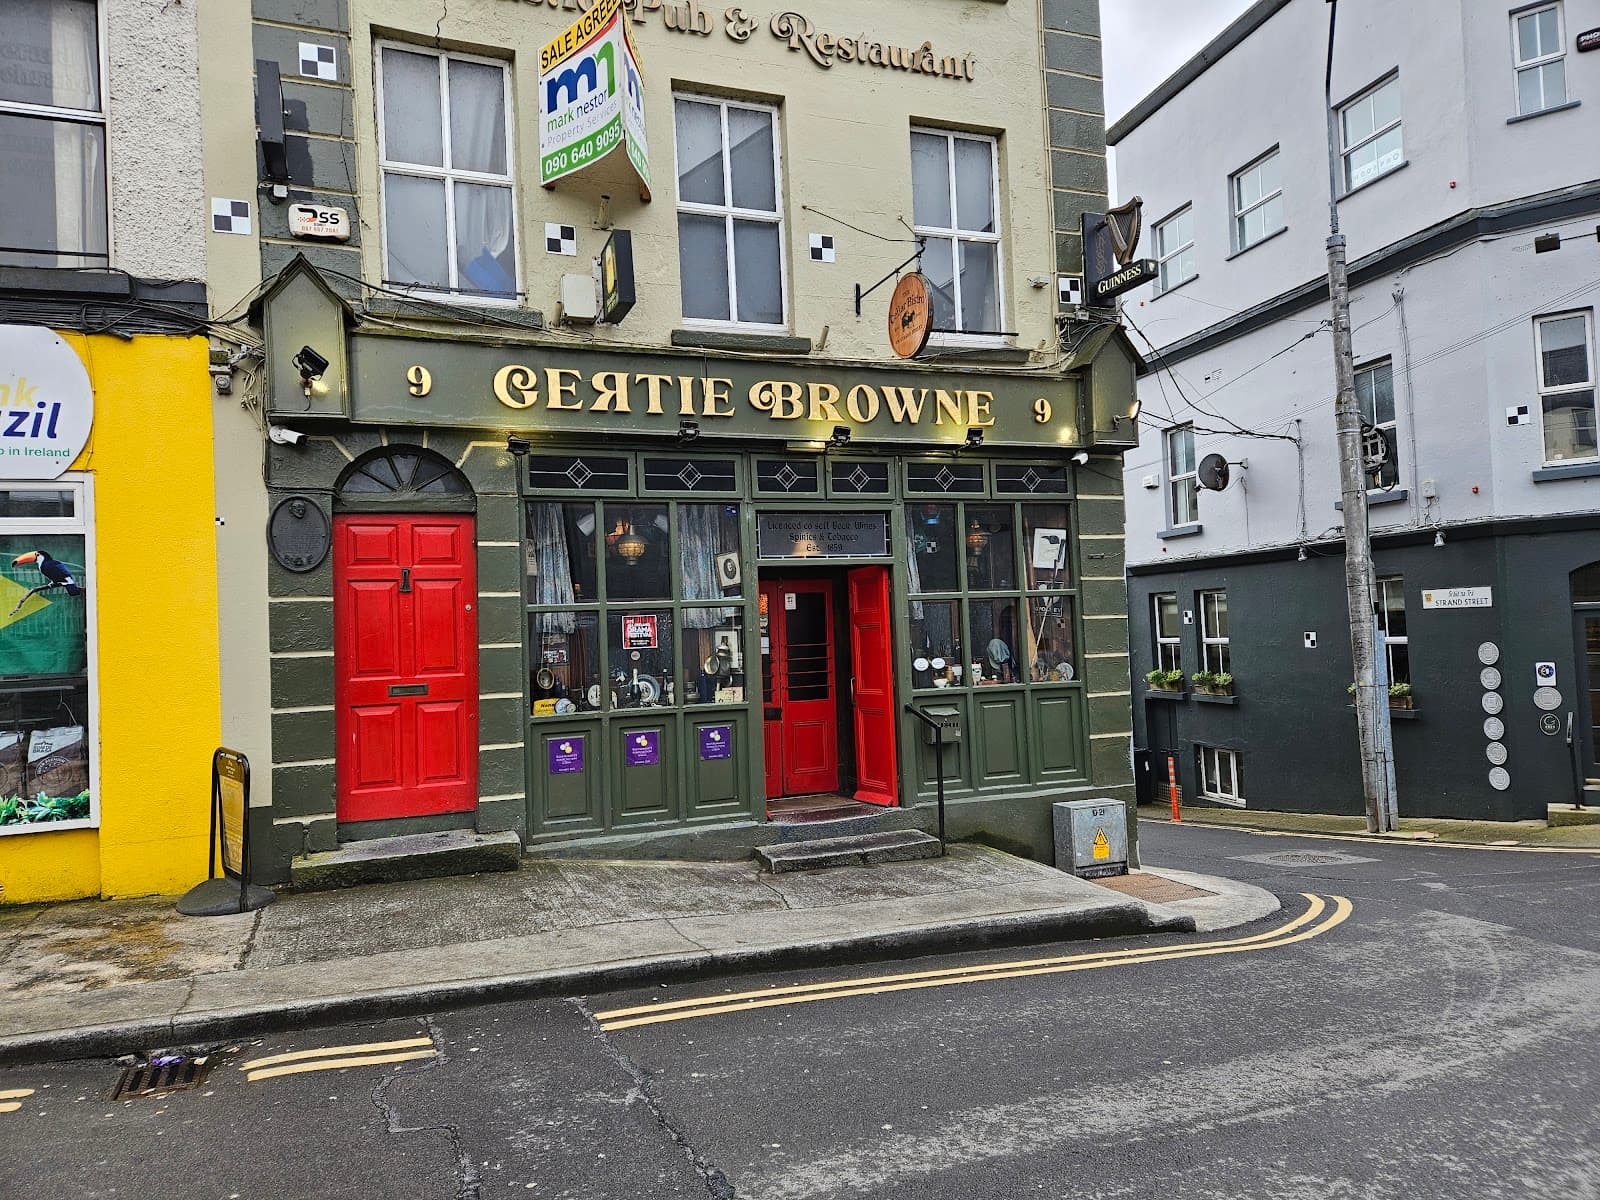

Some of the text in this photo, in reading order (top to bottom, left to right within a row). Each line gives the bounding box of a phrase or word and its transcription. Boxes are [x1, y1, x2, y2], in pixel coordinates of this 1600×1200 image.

[542, 32, 573, 69] SALE
[576, 0, 618, 45] AGREE
[724, 7, 760, 43] &
[770, 12, 976, 81] Restaurant
[547, 109, 575, 134] mark
[576, 88, 608, 118] nestor
[547, 120, 585, 146] Property
[586, 101, 617, 127] Services
[545, 119, 621, 175] 090 640 9095
[1097, 264, 1142, 294] GUINNESS
[406, 364, 1052, 426] 9 GERTIE BROWNE 9
[8, 446, 70, 457] in Ireland
[1435, 597, 1489, 607] STRAND STREET
